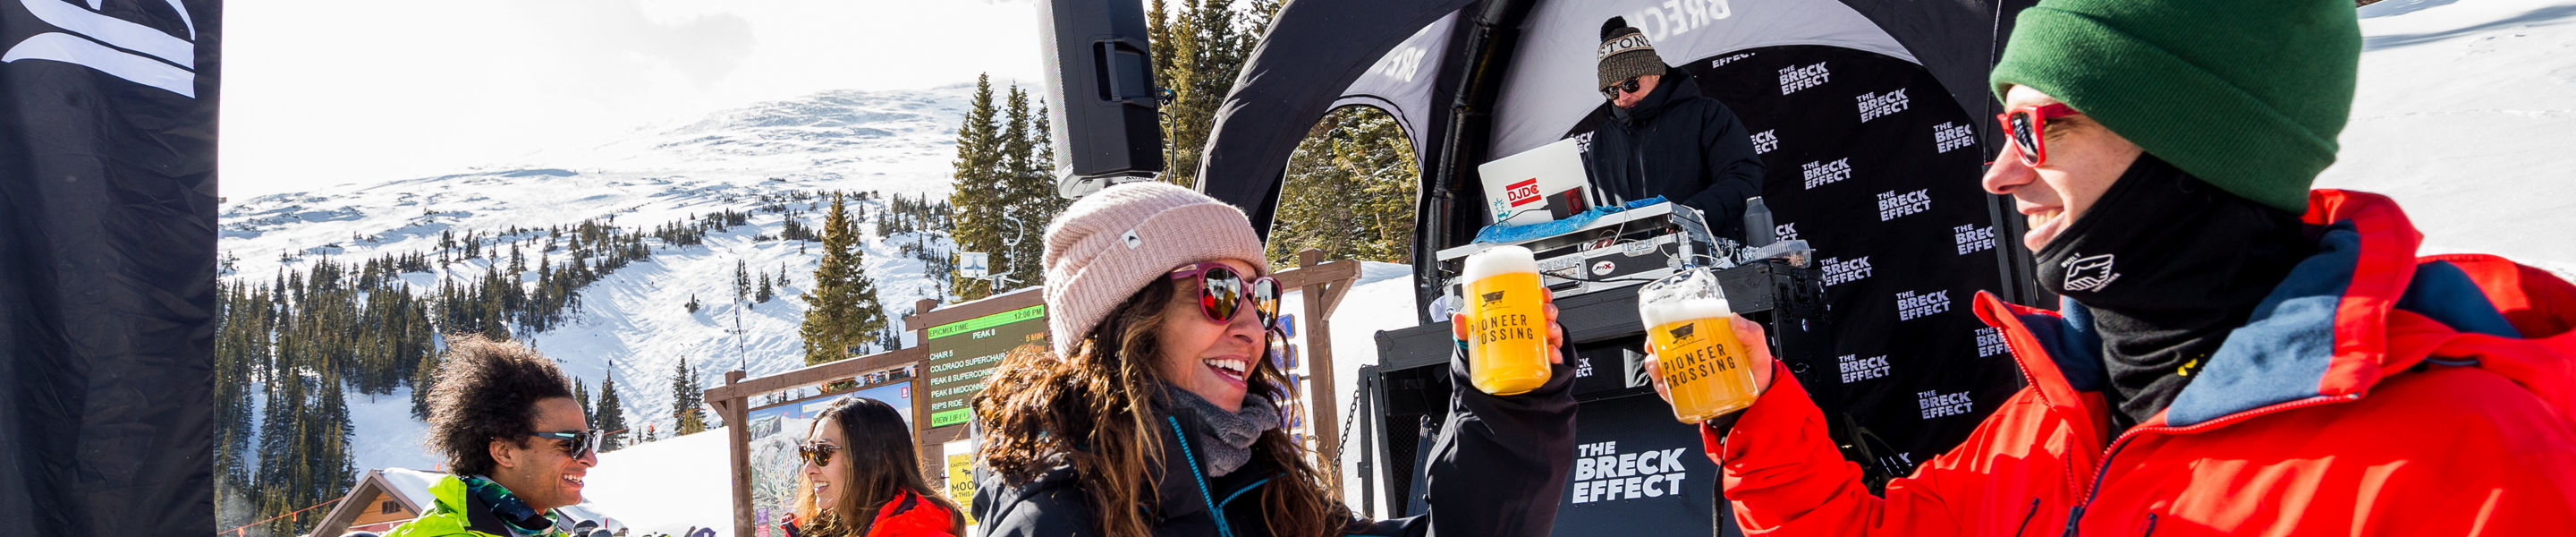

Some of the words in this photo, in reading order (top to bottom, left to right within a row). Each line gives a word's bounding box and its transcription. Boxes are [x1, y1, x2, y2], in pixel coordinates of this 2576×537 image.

[1778, 64, 1796, 75] THE
[1779, 61, 1829, 86] BRECK
[1781, 72, 1830, 96] EFFECT
[1856, 91, 1875, 103] THE
[1858, 88, 1908, 114] BRECK
[1860, 98, 1909, 124] EFFECT
[1933, 121, 1953, 132] THE
[1801, 160, 1819, 170] THE
[1803, 157, 1850, 181] BRECK
[1805, 168, 1852, 190] EFFECT
[1877, 190, 1895, 200] THE
[1878, 188, 1930, 211] BRECK
[1880, 200, 1931, 222] EFFECT
[1953, 224, 1973, 234] THE
[1819, 256, 1838, 266] THE
[1821, 256, 1871, 276] BRECK
[1826, 267, 1872, 286] EFFECT
[1896, 290, 1915, 300] THE
[1897, 289, 1949, 311] BRECK
[1899, 301, 1951, 321] EFFECT
[954, 322, 969, 334] TIME
[1032, 308, 1042, 316] PM
[1470, 314, 1528, 333] PIONEER
[972, 329, 990, 339] PEAK
[991, 328, 996, 337] 8
[1975, 327, 1995, 336] THE
[930, 350, 948, 361] CHAIR
[949, 349, 953, 357] 5
[930, 360, 964, 373] COLORADO
[965, 353, 1005, 366] SUPERCHAIR
[1664, 343, 1726, 375] PIONEER
[1839, 354, 1856, 362] THE
[1839, 355, 1889, 373] BRECK
[931, 377, 947, 386] PEAK
[1666, 356, 1736, 389] CROSSING
[1842, 366, 1891, 384] EFFECT
[931, 389, 948, 398] PEAK
[1918, 389, 1936, 398] THE
[1919, 391, 1971, 410] BRECK
[948, 399, 963, 407] RIDE
[1921, 402, 1973, 420] EFFECT
[933, 415, 948, 424] VIEW
[1579, 441, 1616, 457] THE
[1575, 448, 1687, 481] BRECK
[1572, 473, 1686, 504] EFFECT
